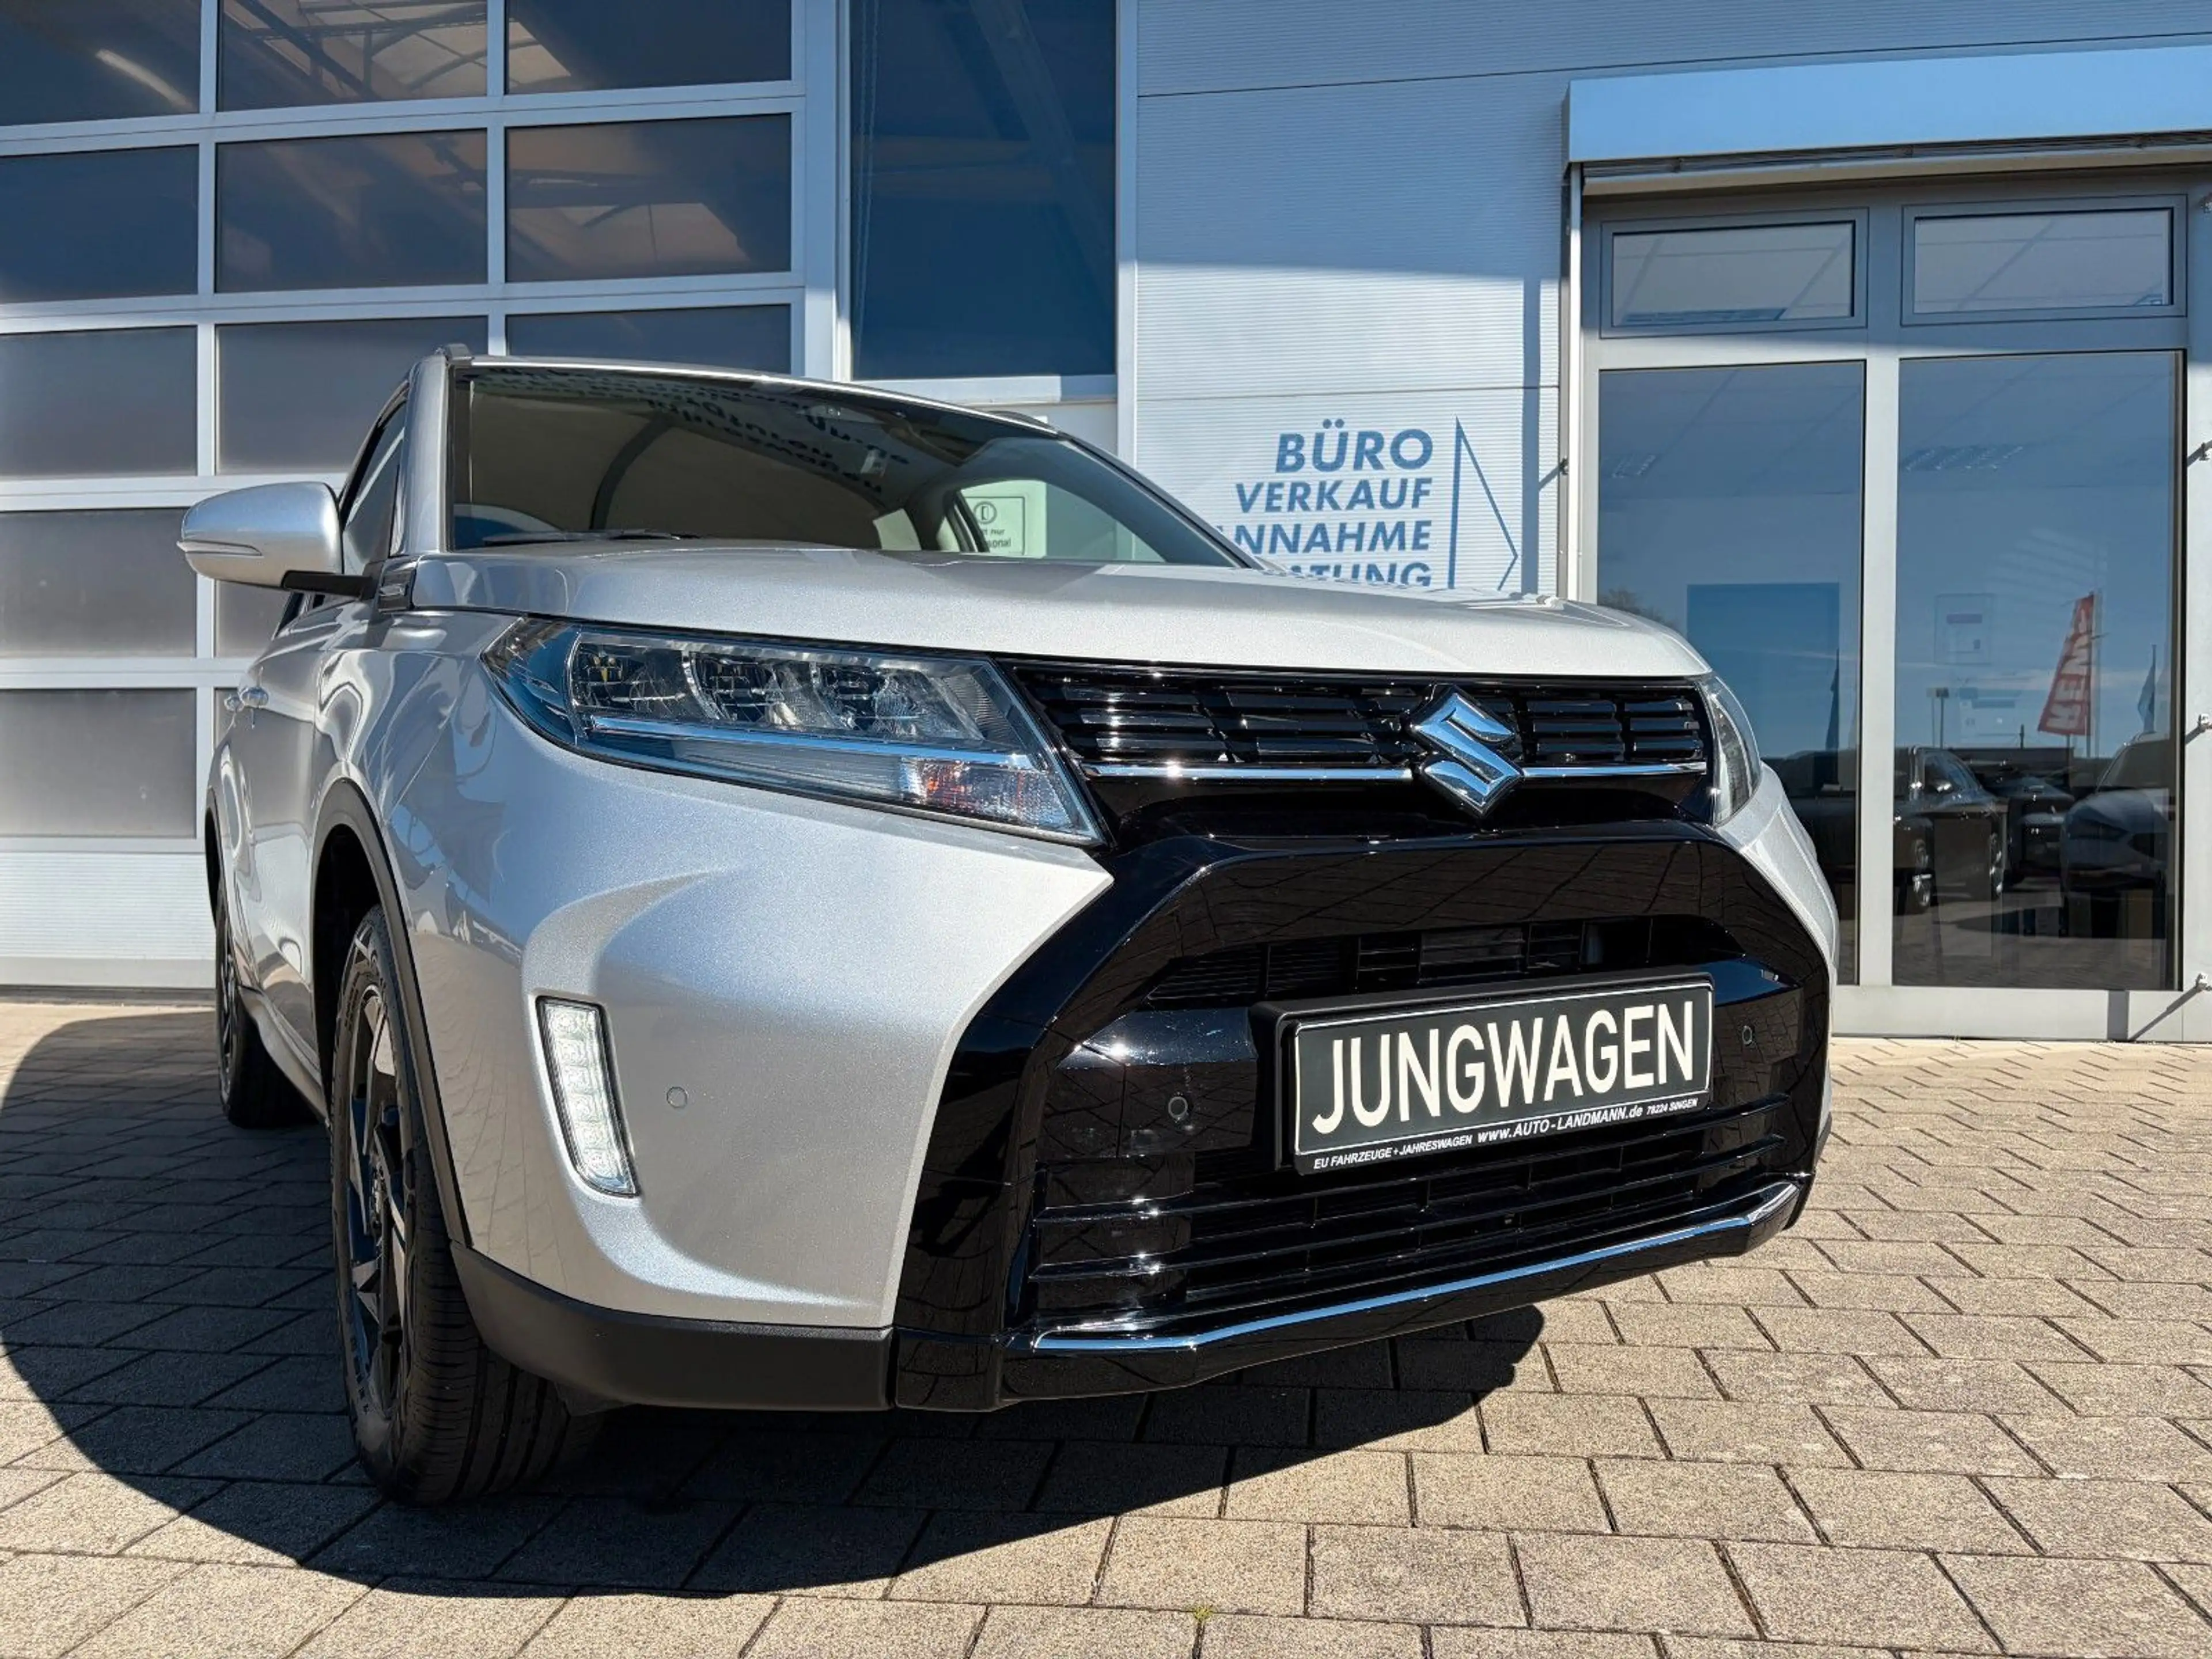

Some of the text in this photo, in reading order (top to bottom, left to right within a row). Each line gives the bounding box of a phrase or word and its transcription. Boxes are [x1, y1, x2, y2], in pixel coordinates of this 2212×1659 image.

[1275, 418, 1434, 474] BÜRO
[1235, 478, 1433, 513] VERKAUF
[1217, 520, 1433, 555] NNAHME
[1312, 1000, 1694, 1135] JUNGWAGEN
[1313, 1158, 1328, 1169] EU
[1330, 1147, 1393, 1166] FAHRZEUGE
[1399, 1134, 1473, 1156] JAHRESWAGEN
